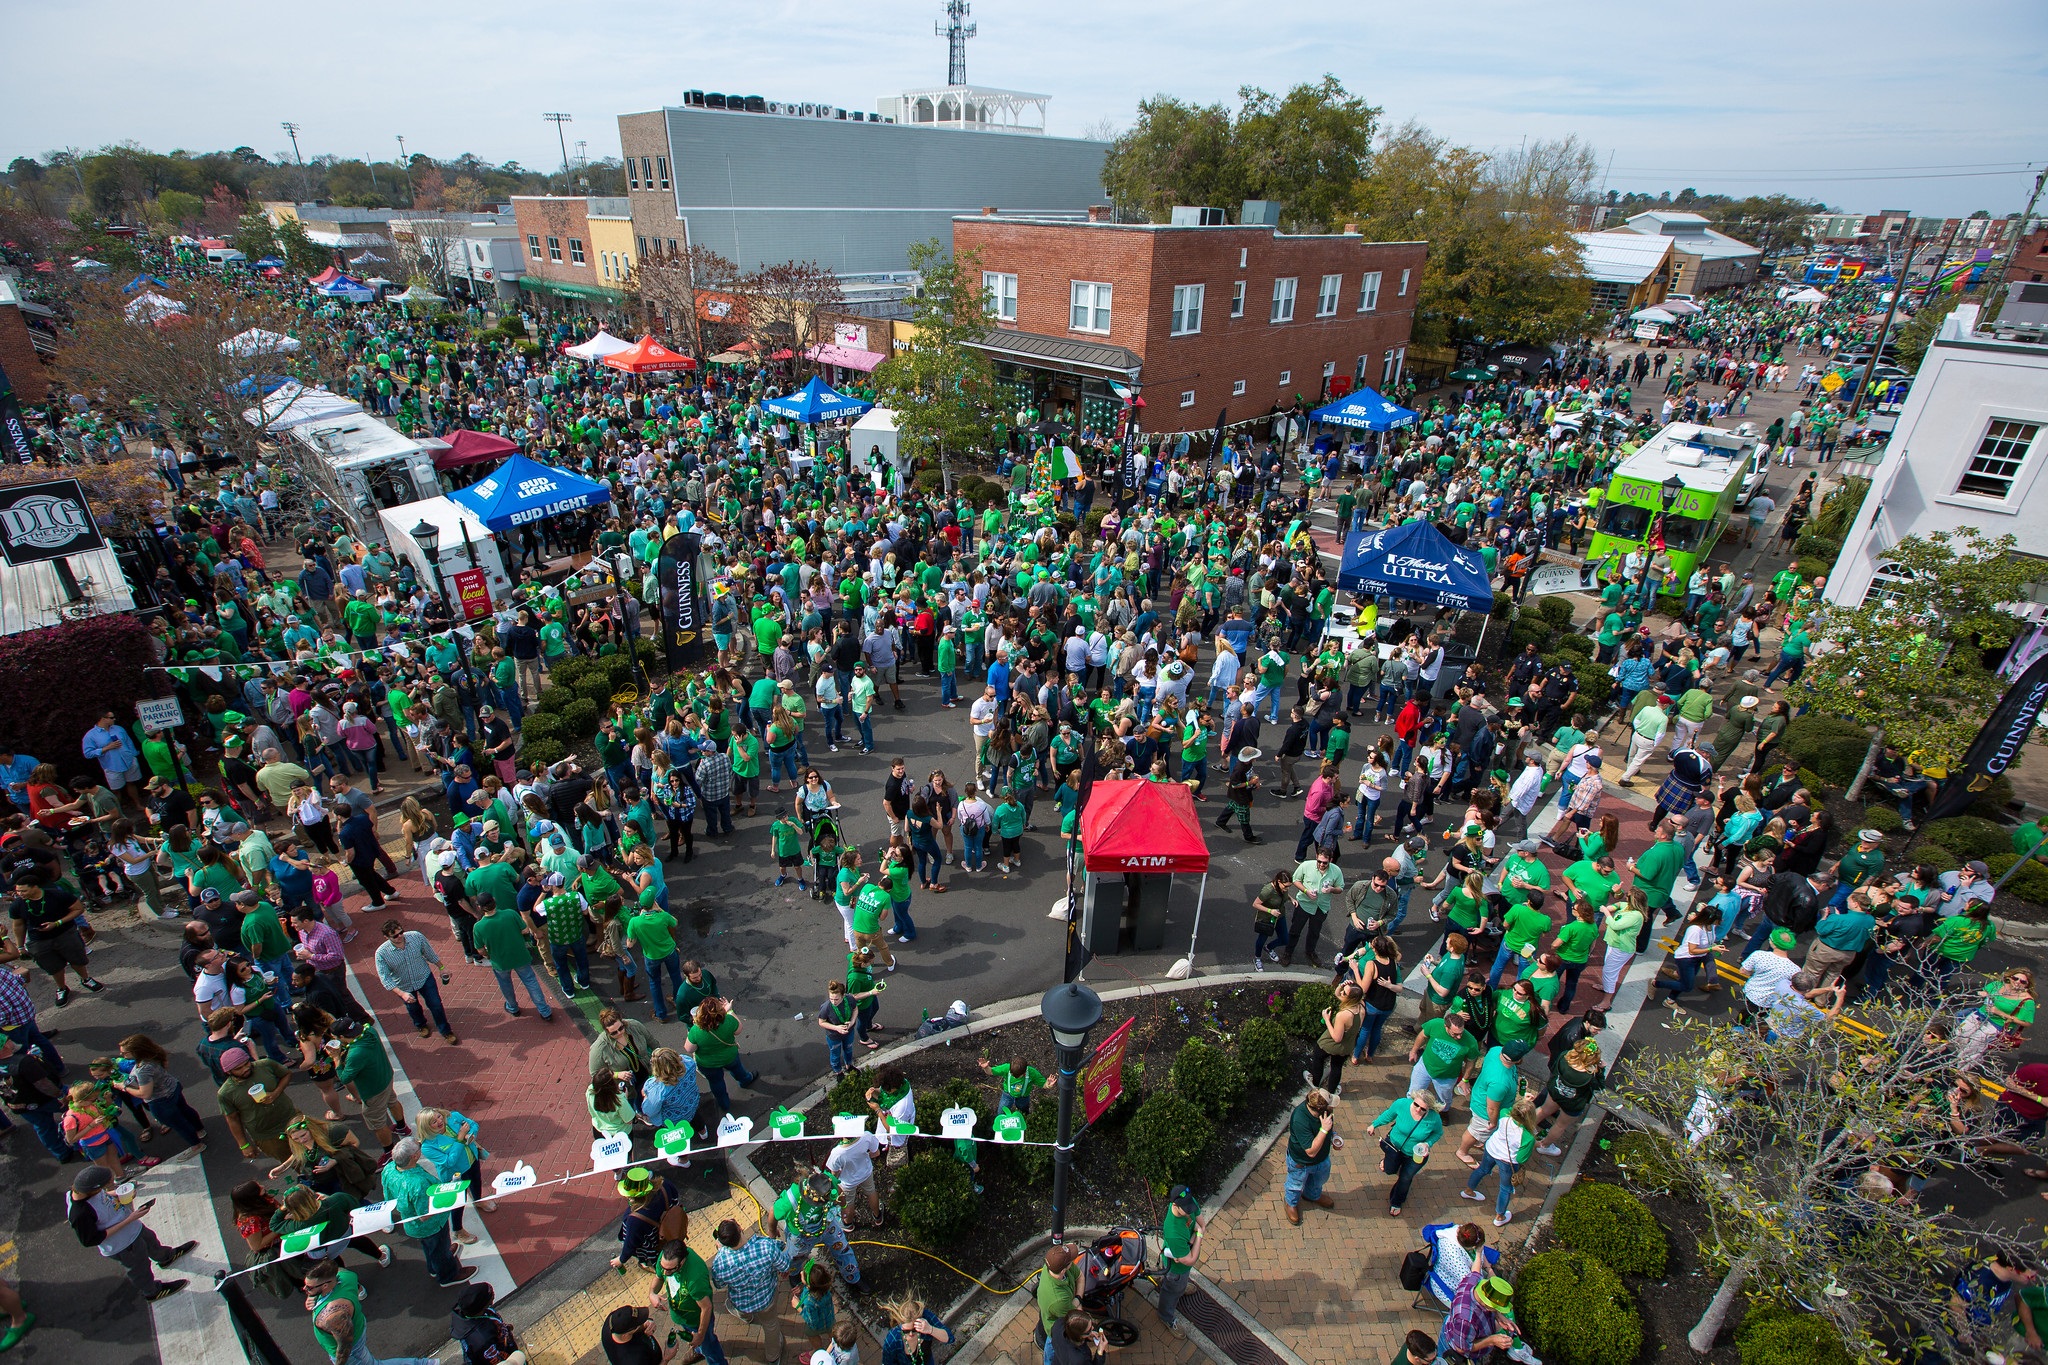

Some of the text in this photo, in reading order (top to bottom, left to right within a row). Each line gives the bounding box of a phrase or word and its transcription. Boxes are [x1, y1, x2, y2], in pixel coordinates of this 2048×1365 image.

[893, 338, 910, 351] HOT
[1516, 355, 1528, 363] CITY
[768, 404, 801, 420] BUD LIGHT
[821, 406, 863, 420] BUD LIGHT
[1341, 408, 1368, 417] LIGHT
[1347, 404, 1368, 412] BUD
[1322, 414, 1371, 429] BUD LIGHT
[6, 417, 33, 465] UINNESS
[1124, 434, 1134, 488] GUINNESS
[517, 482, 558, 499] LIGHT
[519, 477, 549, 491] BUD
[510, 494, 589, 526] BUD LIGHT
[0, 498, 88, 540] DIG
[16, 535, 27, 543] IN
[28, 530, 52, 541] THE
[52, 526, 83, 537] PARK
[1395, 555, 1449, 572] Michelob
[460, 574, 478, 583] SHOP
[1382, 563, 1456, 586] ULTRA
[1538, 569, 1576, 579] GUINNESS
[461, 586, 486, 601] local
[676, 561, 693, 629] GUINNESS
[1357, 584, 1389, 595] ULTRA
[1436, 596, 1470, 609] ULTRA
[142, 702, 175, 714] PUBLIC
[142, 709, 180, 722] PARKING
[1987, 682, 2048, 774] GUINNESS
[1126, 856, 1167, 867] ATM
[858, 891, 881, 908] DILLY
[1100, 1033, 1123, 1055] SHOP
[1433, 1038, 1457, 1055] ROLLING
[1097, 1044, 1118, 1064] DINE
[601, 1140, 622, 1152] LIGHT
[604, 1147, 620, 1156] BUD
